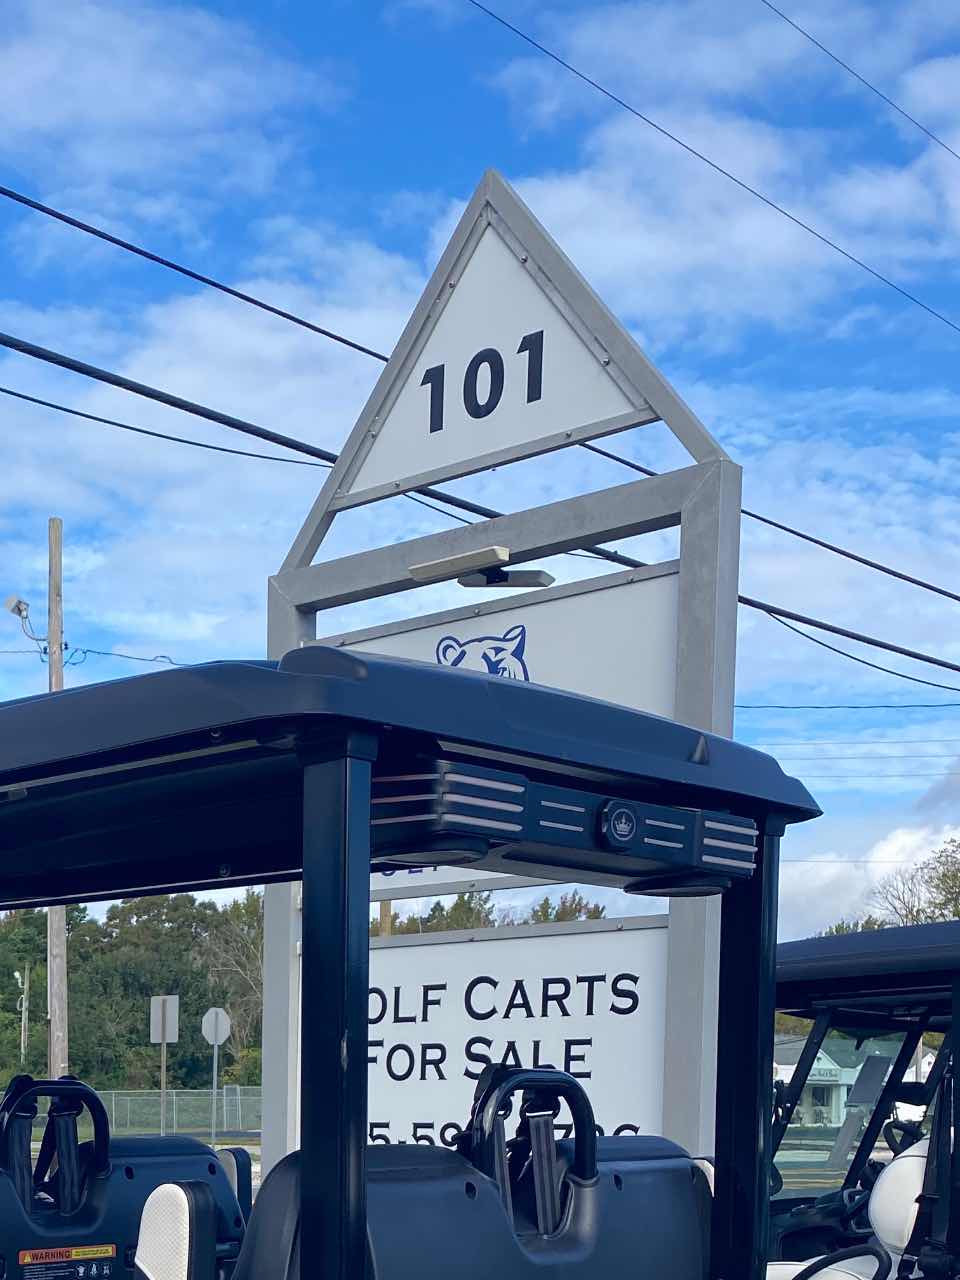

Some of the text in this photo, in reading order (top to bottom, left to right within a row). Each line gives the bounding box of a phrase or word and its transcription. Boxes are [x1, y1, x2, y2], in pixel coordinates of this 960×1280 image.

[419, 329, 544, 434] 101
[368, 972, 640, 1025] OLF CARTS
[31, 1248, 72, 1262] WARNING
